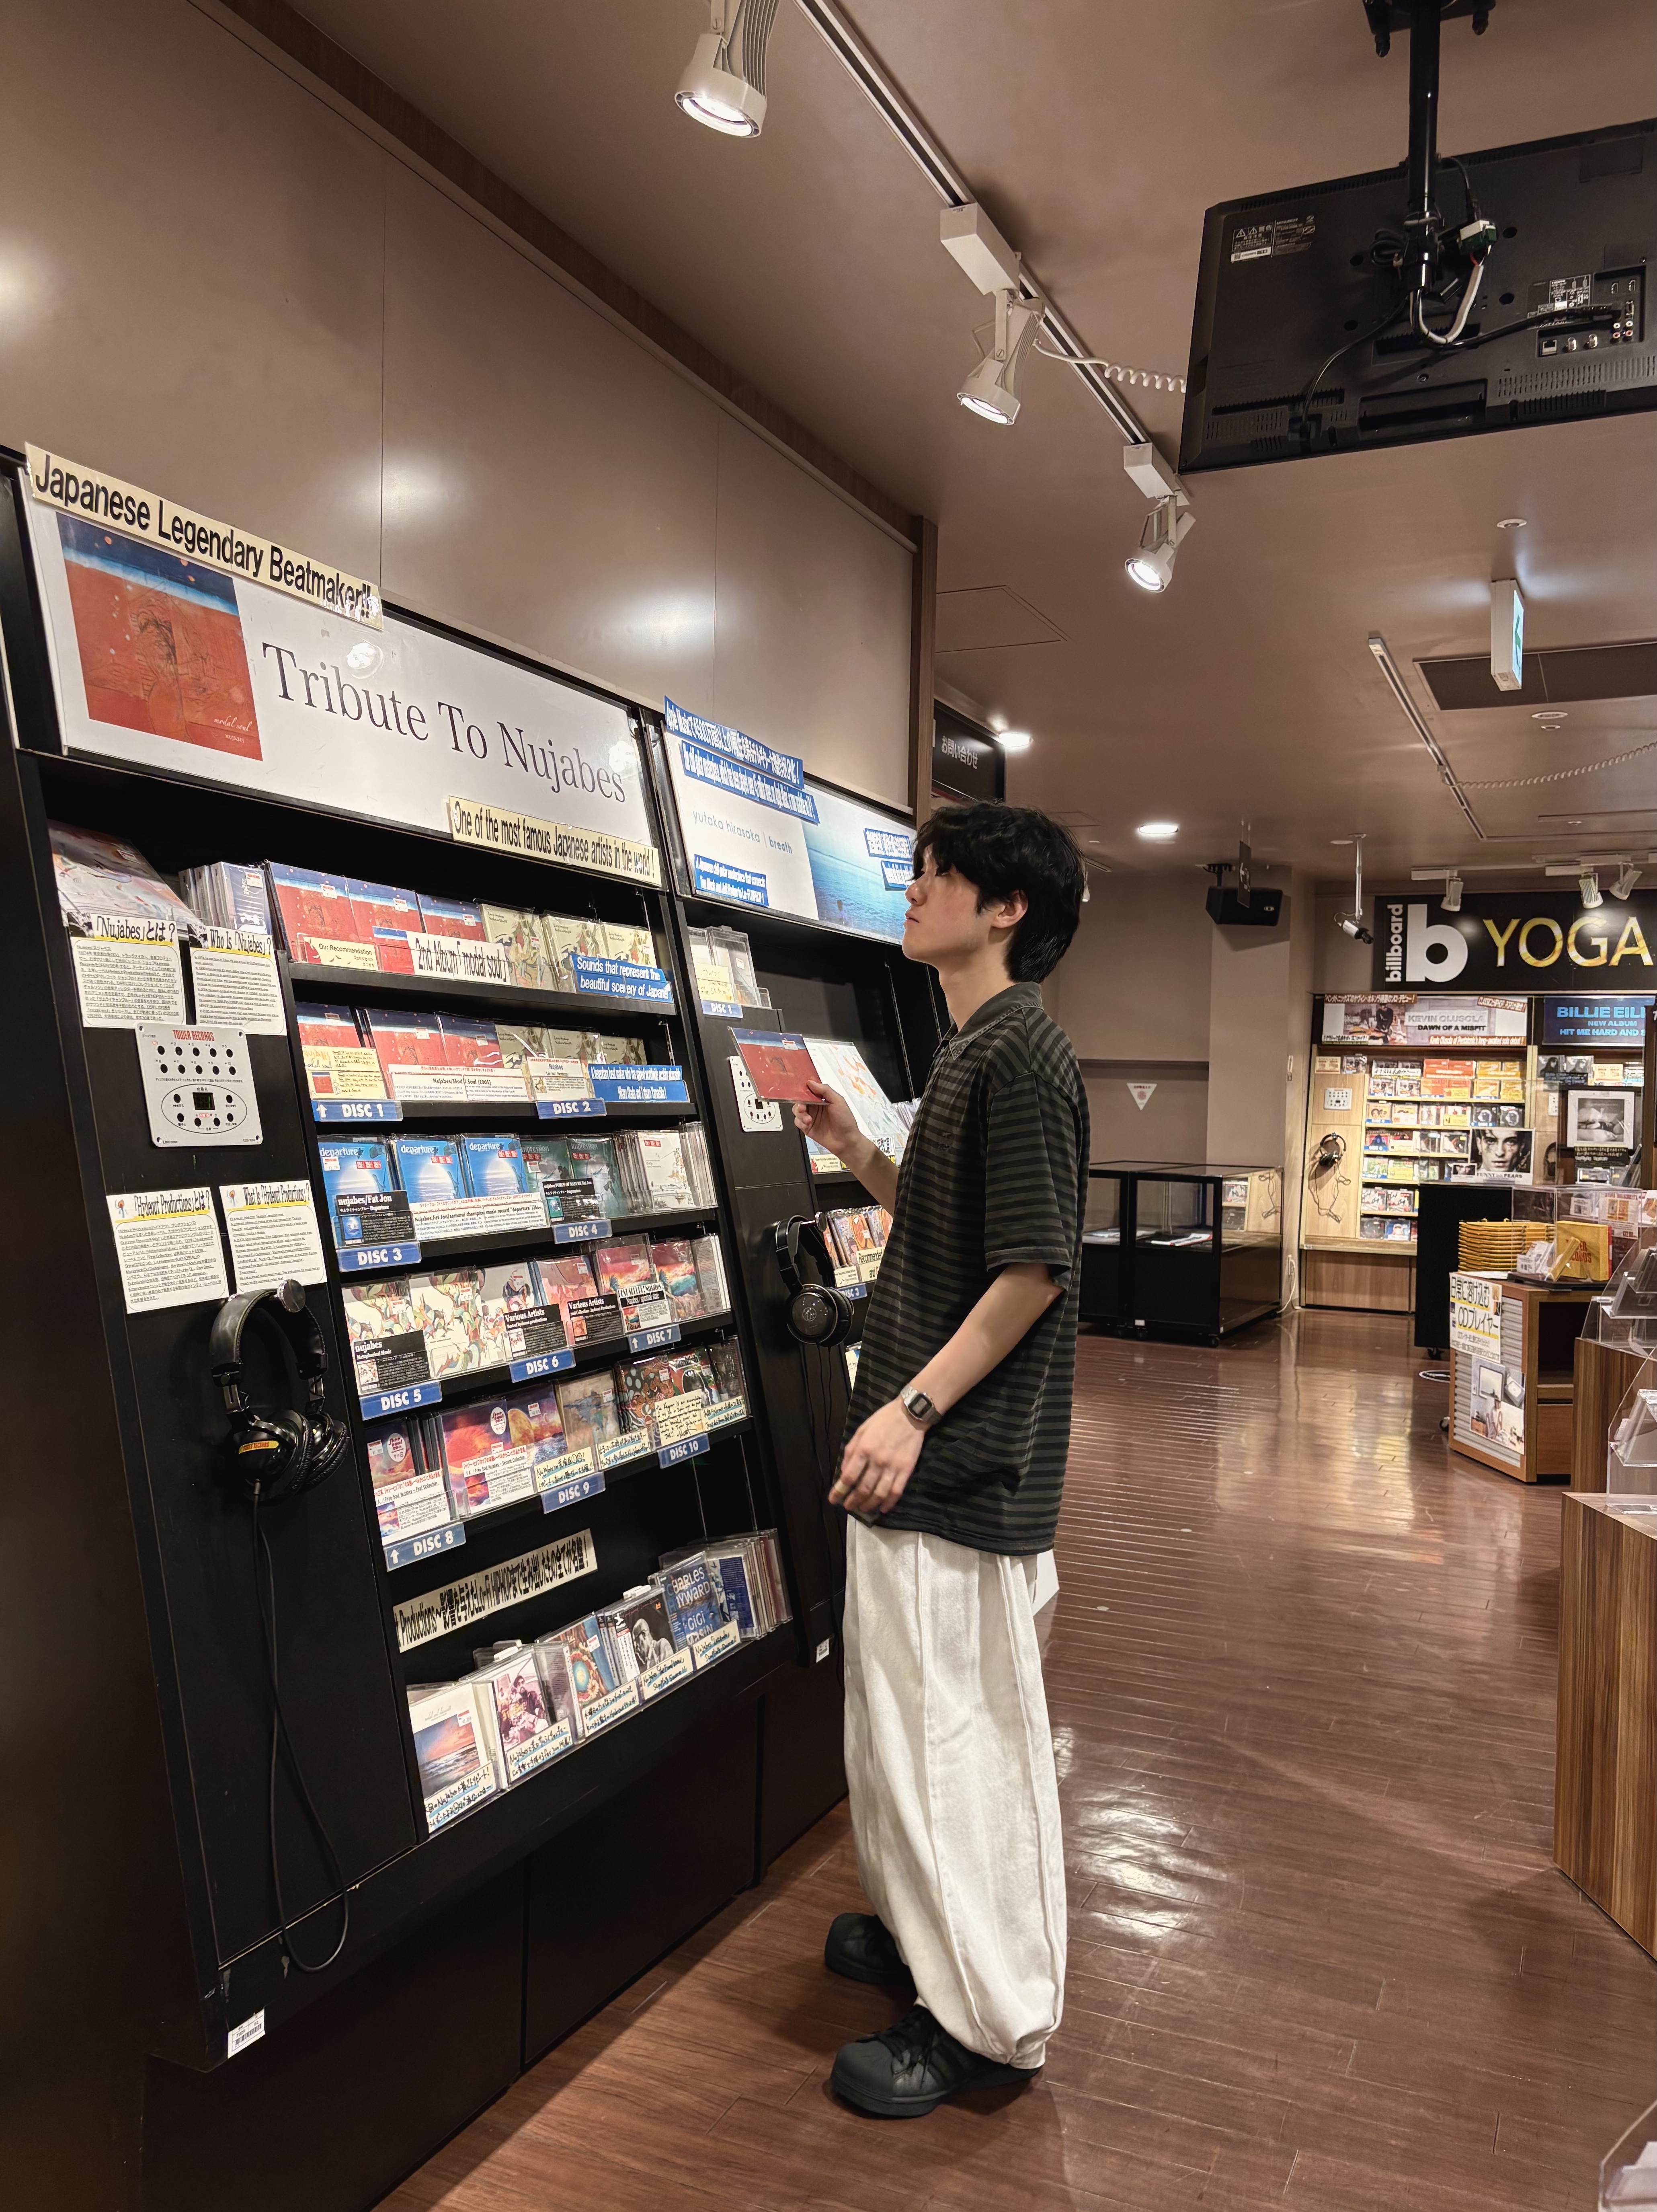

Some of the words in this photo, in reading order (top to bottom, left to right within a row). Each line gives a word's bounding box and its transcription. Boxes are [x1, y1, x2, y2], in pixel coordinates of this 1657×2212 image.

[35, 455, 150, 530] Japanese
[158, 500, 263, 578] Legendary
[271, 545, 371, 618] Beatmaker!!
[214, 715, 237, 727] modal
[236, 721, 252, 731] soul
[262, 642, 429, 741] Tribute
[438, 702, 487, 758] To
[497, 722, 625, 803] Nujabes
[941, 736, 978, 769] お問い合わせ
[453, 801, 472, 836] One
[475, 807, 483, 839] of
[486, 809, 498, 843] the
[501, 817, 521, 845] most
[523, 818, 551, 854] famous
[554, 826, 589, 861] Japanese
[591, 836, 613, 867] artists
[614, 840, 620, 869] in
[621, 843, 632, 873] the
[693, 810, 724, 830] yutaka
[726, 819, 761, 843] hirasaka
[769, 837, 793, 854] breath
[210, 929, 225, 948] Who
[226, 932, 232, 949] Is
[1386, 904, 1403, 982] billboard
[1406, 904, 1468, 982] b
[1483, 917, 1654, 967] YOGA
[330, 945, 373, 956] Recommendation
[415, 938, 433, 971] 2nd
[435, 941, 458, 974] Album
[577, 956, 604, 972] Sounds
[605, 961, 619, 975] that
[619, 964, 649, 980] represent
[650, 968, 661, 981] the
[580, 975, 610, 992] beautiful
[611, 980, 637, 998] scenery
[638, 982, 646, 995] of
[711, 1002, 727, 1014] DISC
[728, 1004, 732, 1014] 1
[1557, 1007, 1610, 1018] BILLIE
[172, 1029, 191, 1040] TOWER
[191, 1031, 215, 1041] RECORDS
[593, 1066, 609, 1080] legendary
[342, 1103, 372, 1118] DISC
[377, 1103, 384, 1117] 1
[552, 1103, 579, 1115] DISC
[582, 1101, 591, 1112] 2
[320, 1146, 359, 1159] departure
[400, 1144, 435, 1156] departure
[469, 1142, 500, 1152] departure
[522, 1145, 550, 1153] mpression
[571, 1142, 598, 1151] impression
[244, 1187, 257, 1205] What
[379, 1194, 392, 1204] Jon
[568, 1225, 589, 1238] DISC
[591, 1224, 598, 1235] 4
[357, 1250, 389, 1265] DISC
[393, 1248, 402, 1261] 3
[855, 1287, 860, 1296] 3
[1451, 1276, 1490, 1308] 日常に溶け込む
[568, 1301, 589, 1310] Various
[588, 1298, 605, 1306] Artists
[504, 1312, 527, 1322] Various
[527, 1308, 545, 1318] Artists
[1458, 1306, 1499, 1335] CDプレイヤー
[647, 1331, 666, 1345] DISC
[666, 1329, 672, 1340] 7
[355, 1341, 383, 1353] nujabes
[356, 1351, 380, 1360] Metaphorical
[526, 1359, 548, 1374] DISC
[552, 1356, 559, 1367] 6
[380, 1392, 409, 1411] DISC
[413, 1389, 422, 1403] 5
[254, 1442, 269, 1450] RECORDS
[670, 1445, 689, 1461] DISC
[689, 1440, 699, 1452] 10
[423, 1481, 438, 1489] Collection
[558, 1487, 580, 1504] DISC
[583, 1481, 590, 1494] 9
[413, 1536, 441, 1556] DISC
[445, 1530, 454, 1544] 8
